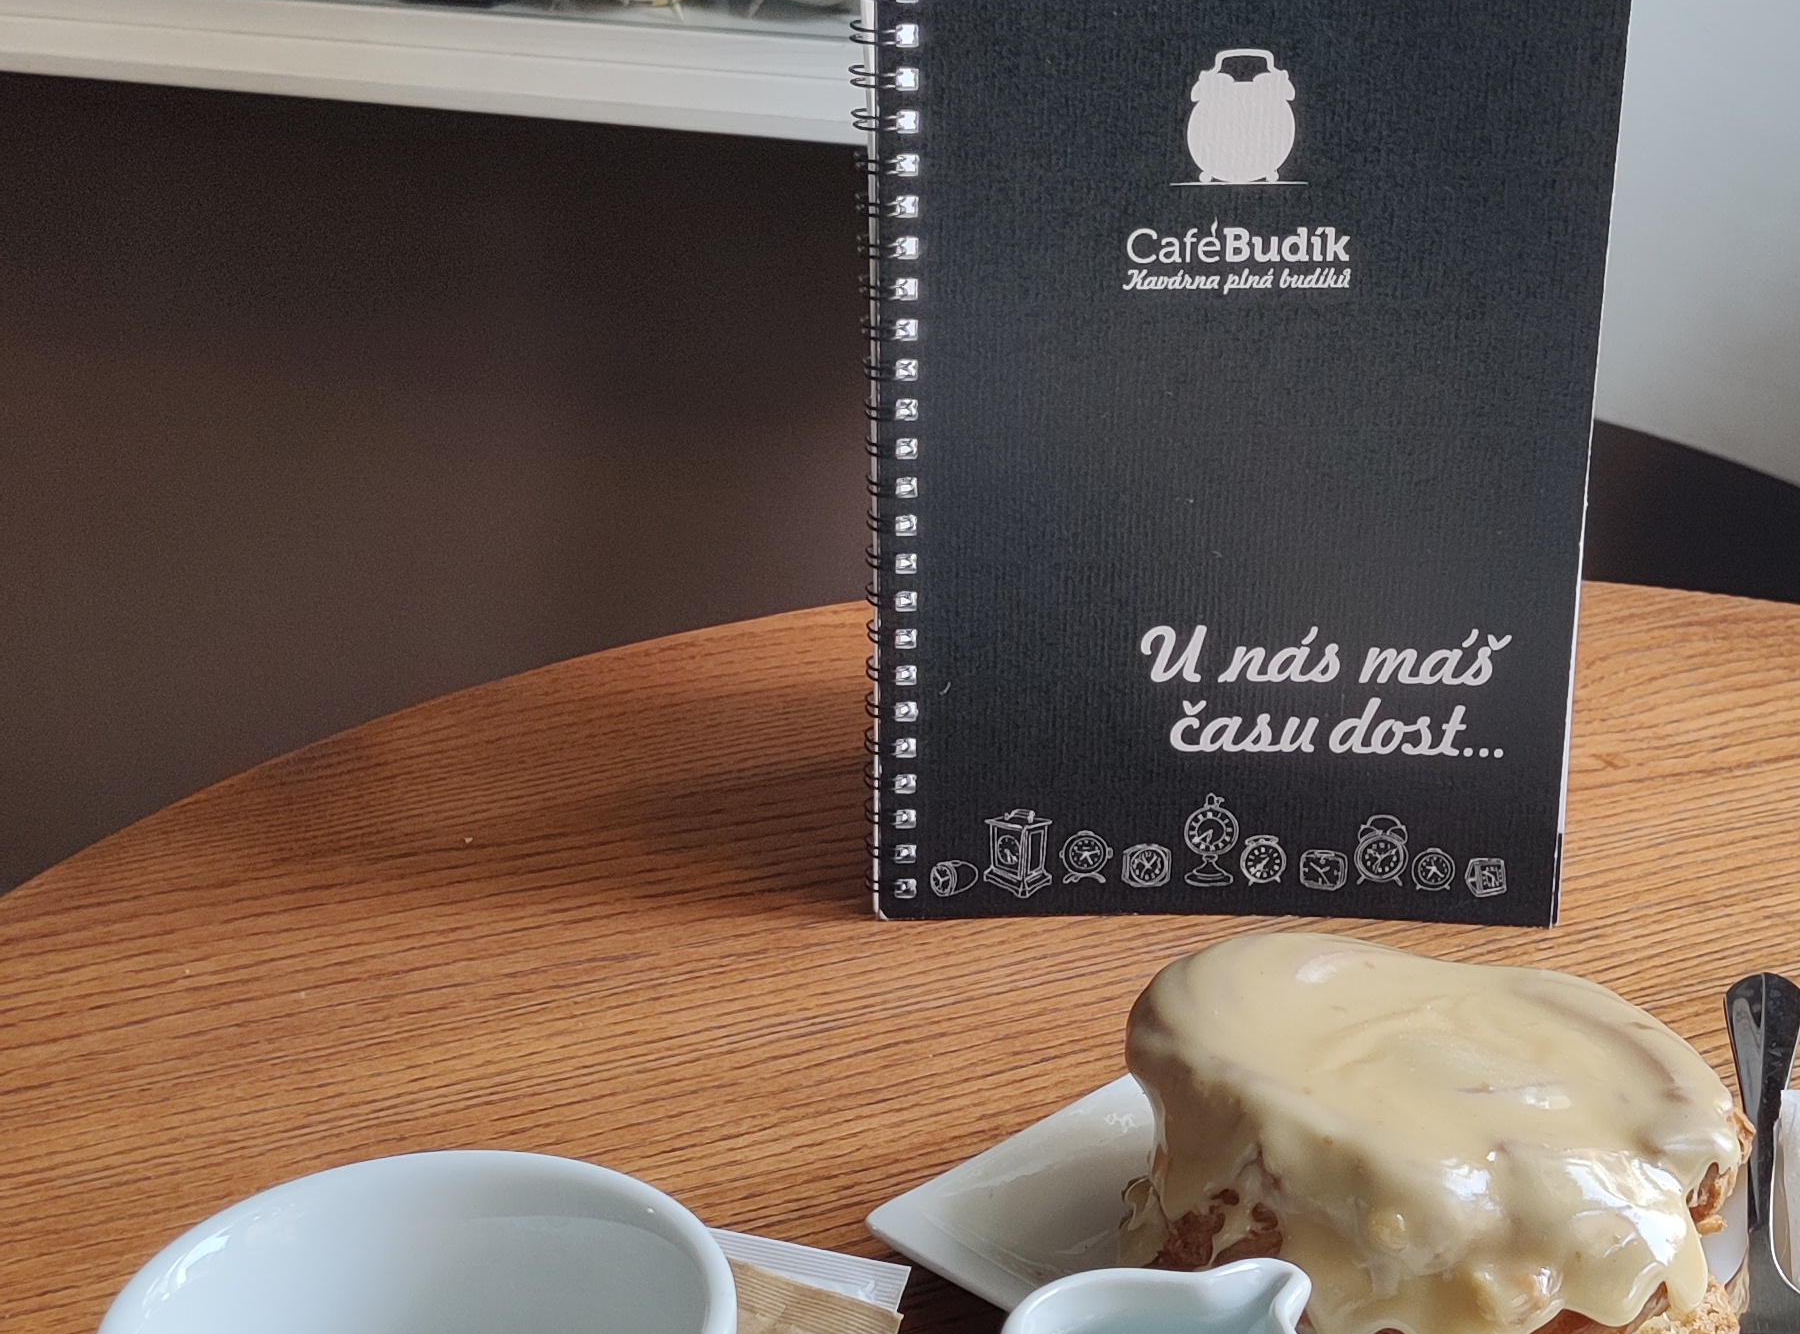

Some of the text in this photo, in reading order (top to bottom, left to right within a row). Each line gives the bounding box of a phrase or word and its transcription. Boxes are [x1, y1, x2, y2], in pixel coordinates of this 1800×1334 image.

[1122, 268, 1351, 295] Kavárna plná budíků
[1140, 624, 1513, 686] U nás máš
[1169, 697, 1504, 759] času dost...
